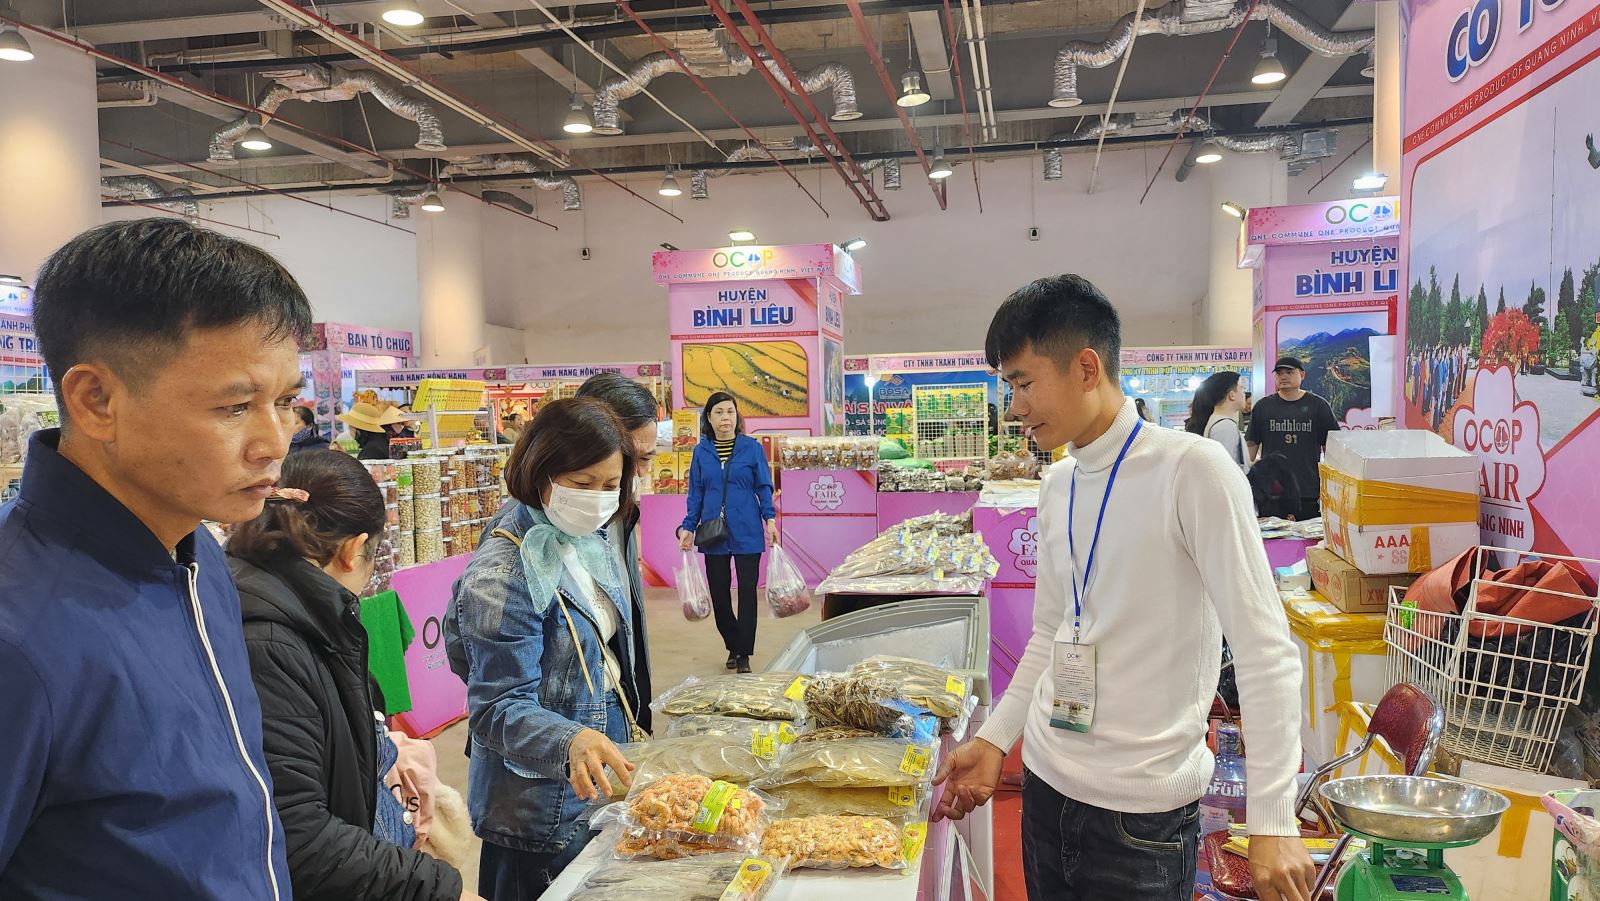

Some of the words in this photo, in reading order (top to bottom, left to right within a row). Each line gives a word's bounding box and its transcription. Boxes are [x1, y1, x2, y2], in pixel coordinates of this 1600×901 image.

[1425, 110, 1459, 138] COMMUNE
[1458, 97, 1474, 115] ONE
[1474, 73, 1511, 106] PRODUCT
[1511, 65, 1523, 80] OF
[1272, 231, 1314, 239] COMMUNE
[1331, 245, 1397, 266] HUYỆN
[1296, 268, 1364, 296] BÌNH
[1374, 269, 1398, 292] LI
[718, 287, 767, 304] HUYỆN
[1338, 300, 1370, 308] PRODUCT
[693, 305, 743, 327] BÌNH
[750, 303, 794, 325] LIÊU
[347, 332, 368, 348] BAN
[903, 359, 915, 368] CTY
[917, 358, 934, 368] TNHH
[935, 357, 956, 367] THANH
[1166, 353, 1174, 361] TY
[1175, 352, 1193, 361] TNHH
[1194, 352, 1209, 361] MTV
[1270, 419, 1312, 432] Badblood
[1284, 433, 1297, 444] 91
[1463, 419, 1522, 455] OCOP
[1480, 461, 1521, 503] AIR
[814, 490, 837, 498] FAIR
[1498, 517, 1524, 539] NINH
[1020, 531, 1038, 542] OC
[1374, 534, 1410, 549] AAA
[1022, 544, 1037, 556] FA
